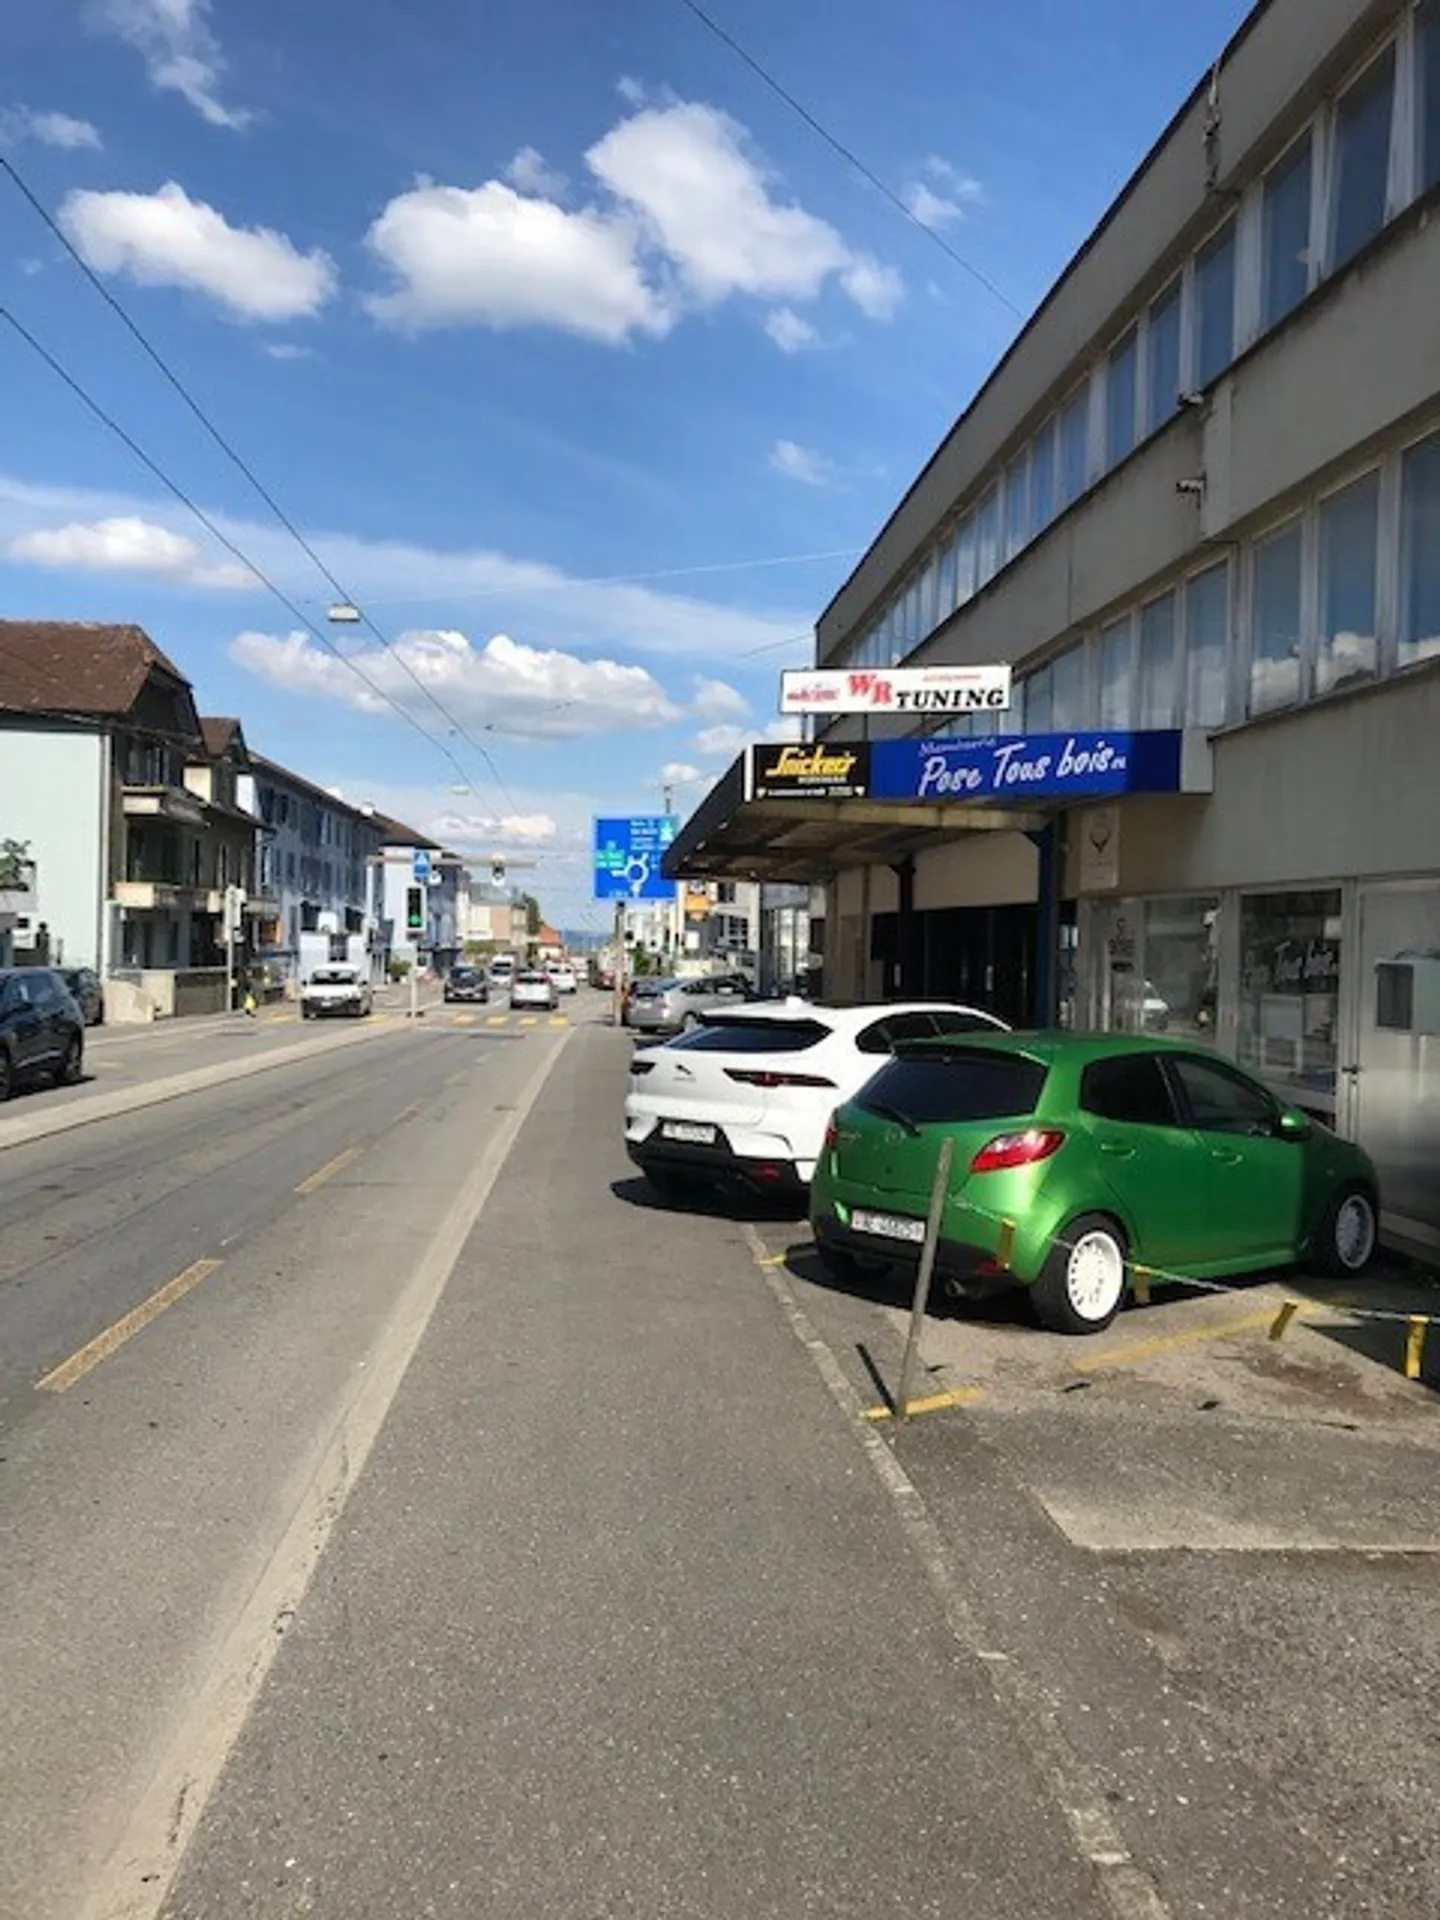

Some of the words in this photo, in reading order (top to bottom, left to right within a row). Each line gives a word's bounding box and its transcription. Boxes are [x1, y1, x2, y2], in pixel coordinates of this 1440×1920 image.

[896, 688, 1004, 709] TUNING
[918, 756, 983, 797] Pose
[993, 741, 1051, 788] Tous
[1056, 738, 1115, 777] bois
